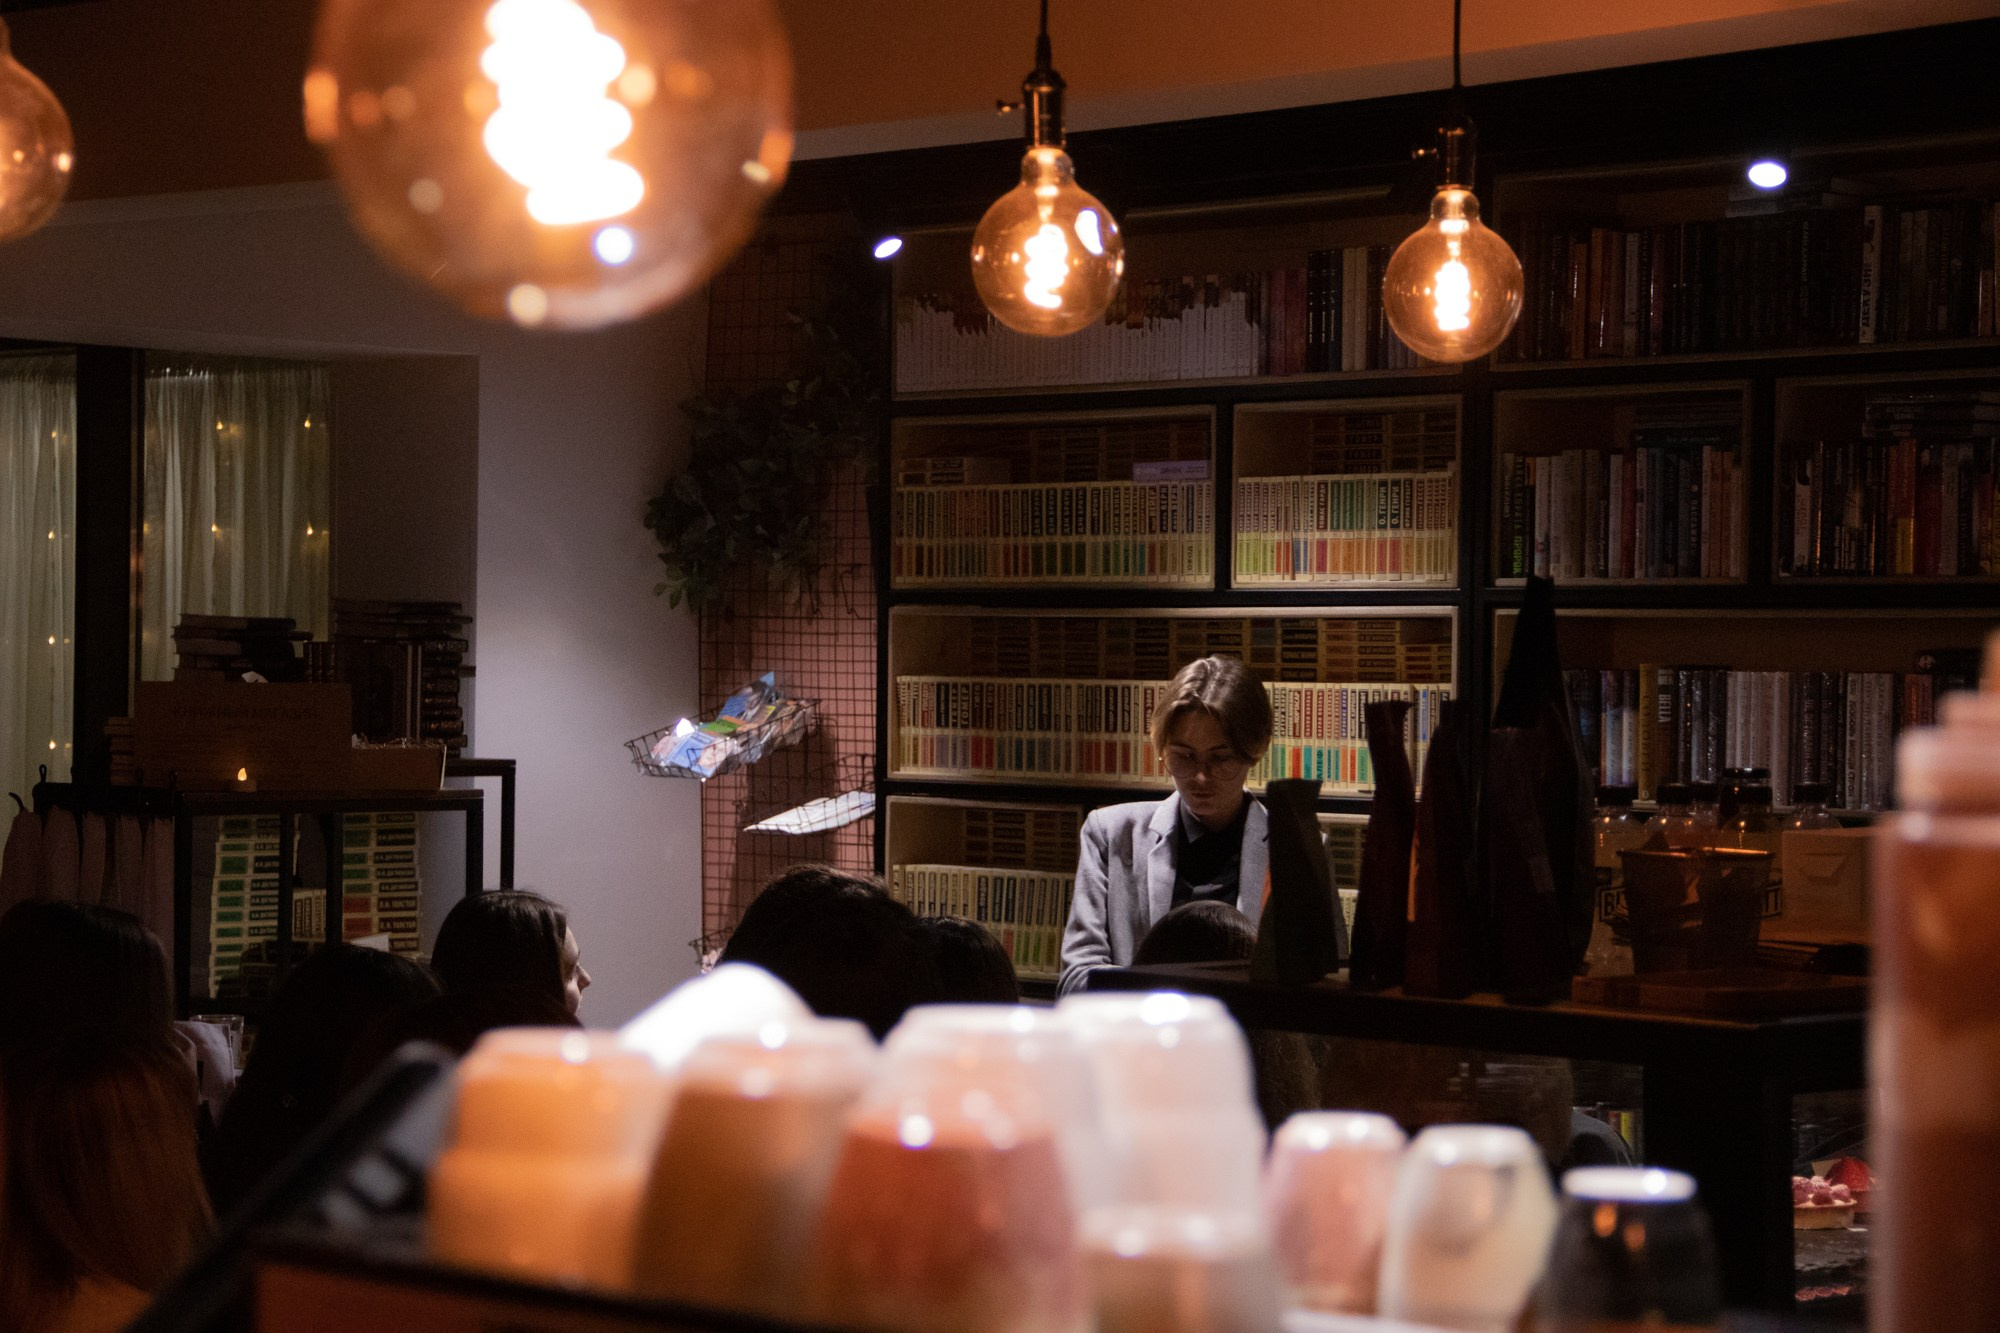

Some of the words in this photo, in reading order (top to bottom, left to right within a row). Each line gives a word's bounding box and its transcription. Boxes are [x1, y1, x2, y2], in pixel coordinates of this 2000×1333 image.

[1379, 516, 1386, 525] О.
[1392, 516, 1399, 525] О.
[1658, 694, 1671, 722] BELLA
